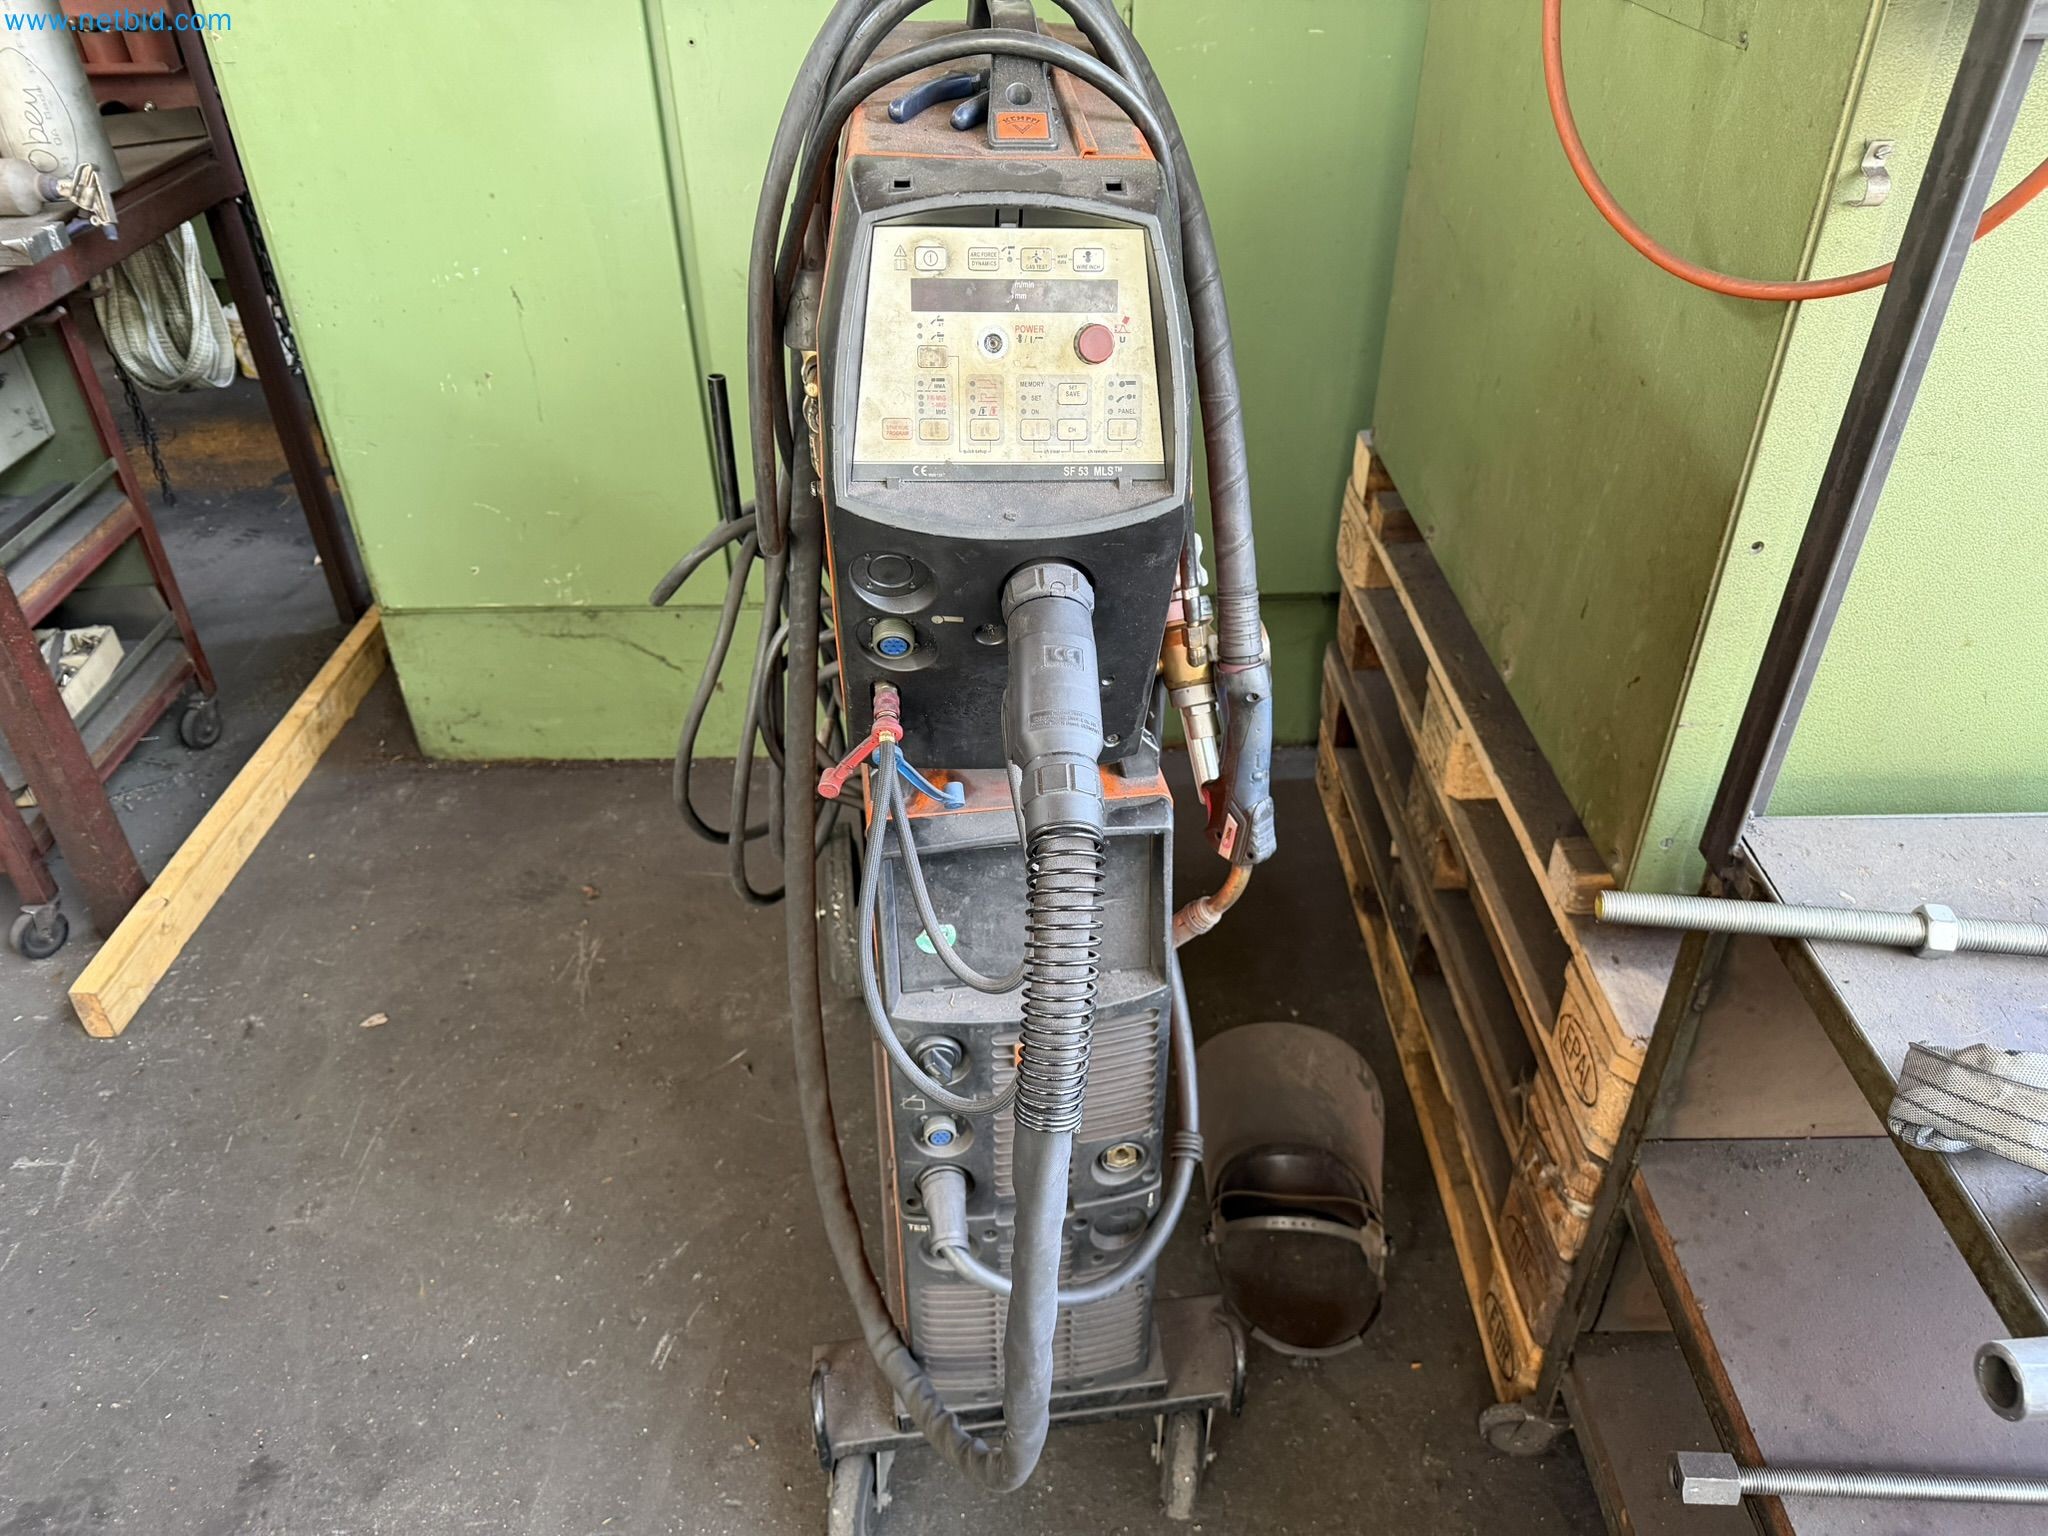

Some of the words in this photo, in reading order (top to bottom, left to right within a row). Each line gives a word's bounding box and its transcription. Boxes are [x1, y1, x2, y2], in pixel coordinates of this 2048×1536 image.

[1014, 281, 1035, 289] m/min
[1014, 303, 1020, 312] A
[1014, 324, 1045, 333] POWER
[1063, 466, 1076, 477] SF
[1078, 466, 1089, 477] 53
[1563, 1022, 1590, 1100] EPAL
